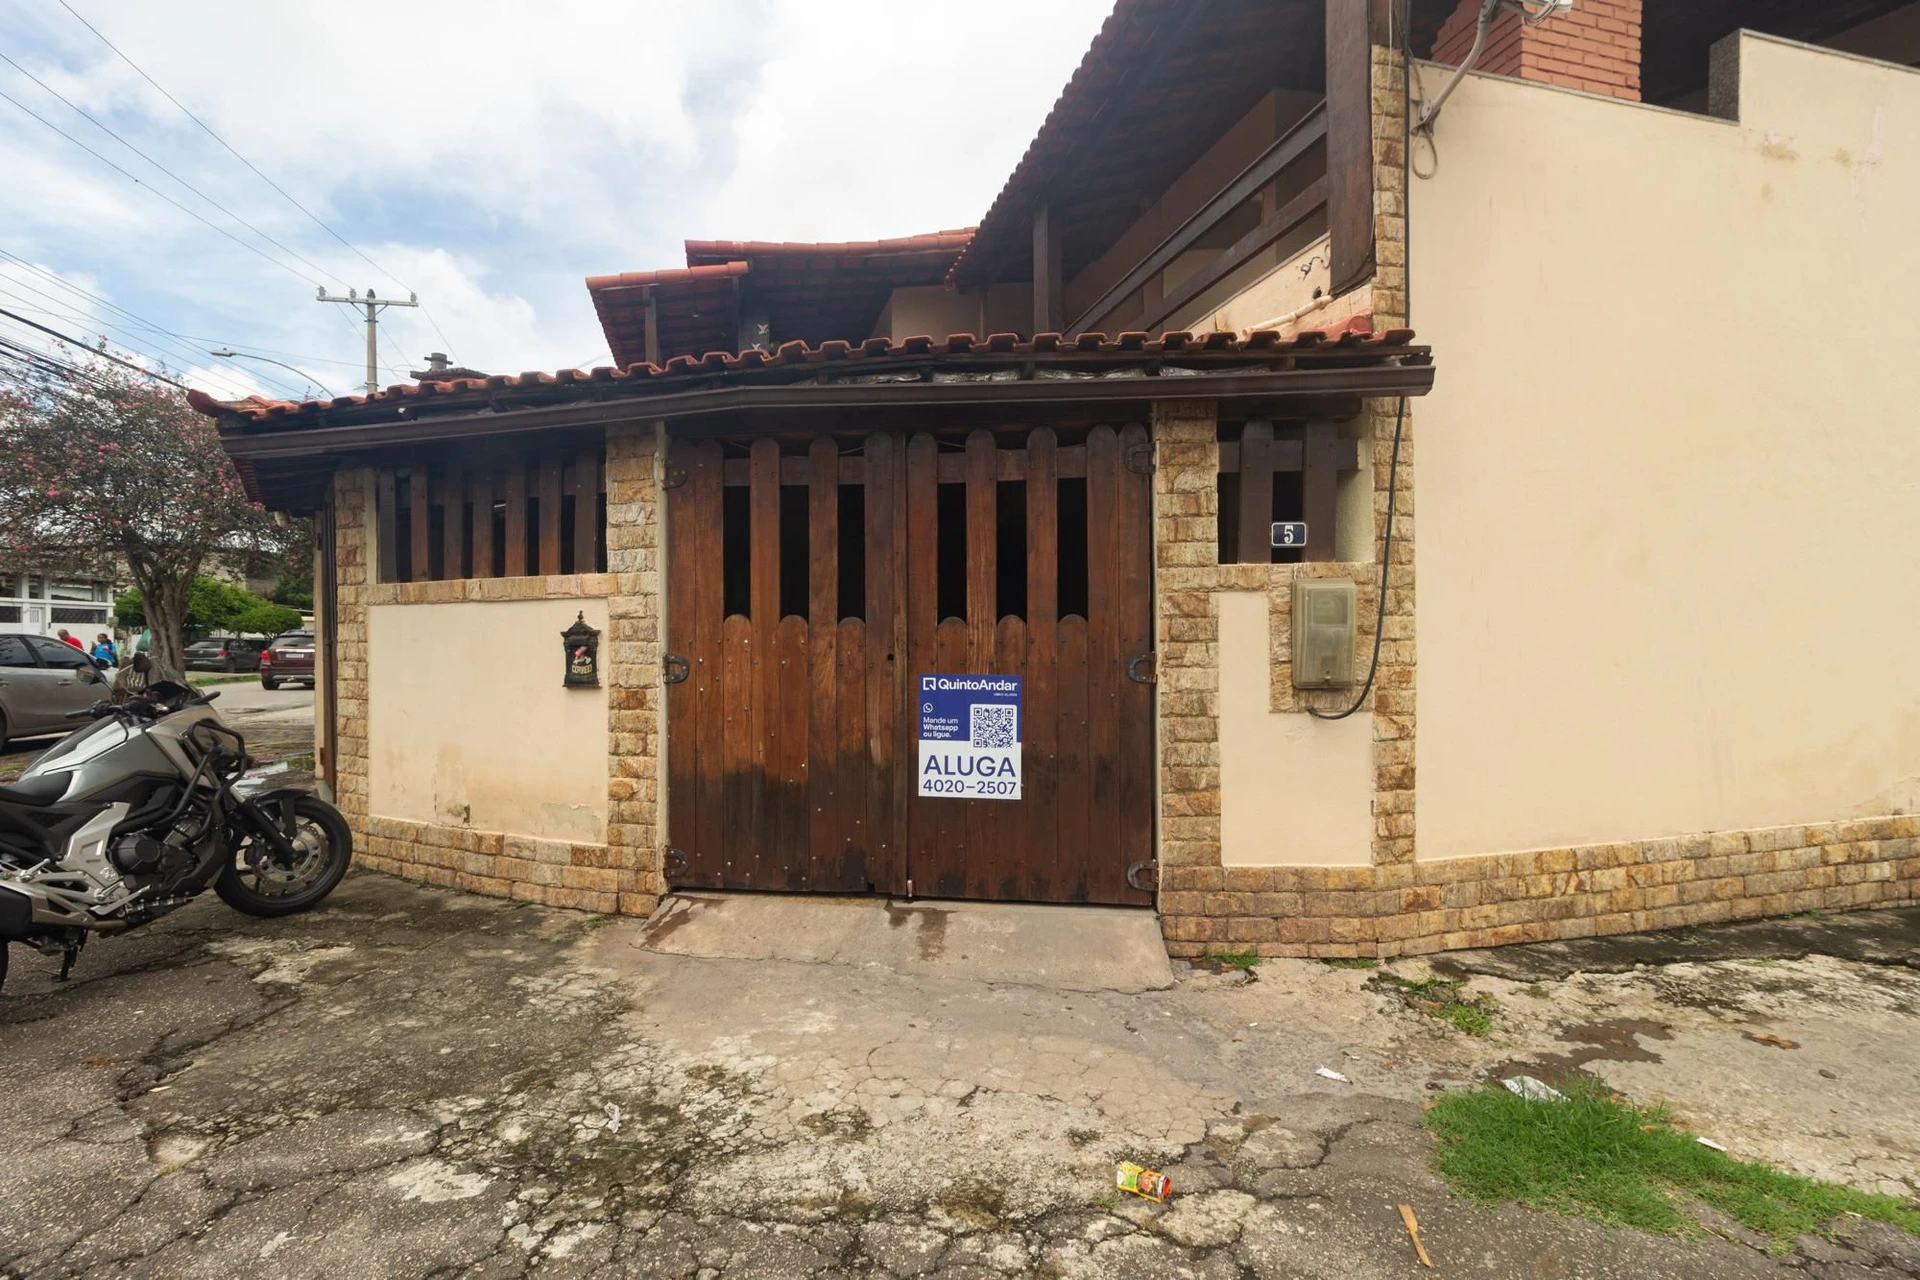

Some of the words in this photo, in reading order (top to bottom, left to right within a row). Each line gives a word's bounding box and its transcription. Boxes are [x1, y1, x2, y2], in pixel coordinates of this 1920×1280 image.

[1284, 525, 1294, 544] 5
[938, 679, 1018, 691] QuintoAndar
[923, 724, 958, 732] Whatsapp
[933, 731, 952, 739] ligue.
[924, 755, 1016, 777] ALUGA
[923, 779, 1017, 795] 4020-2507
